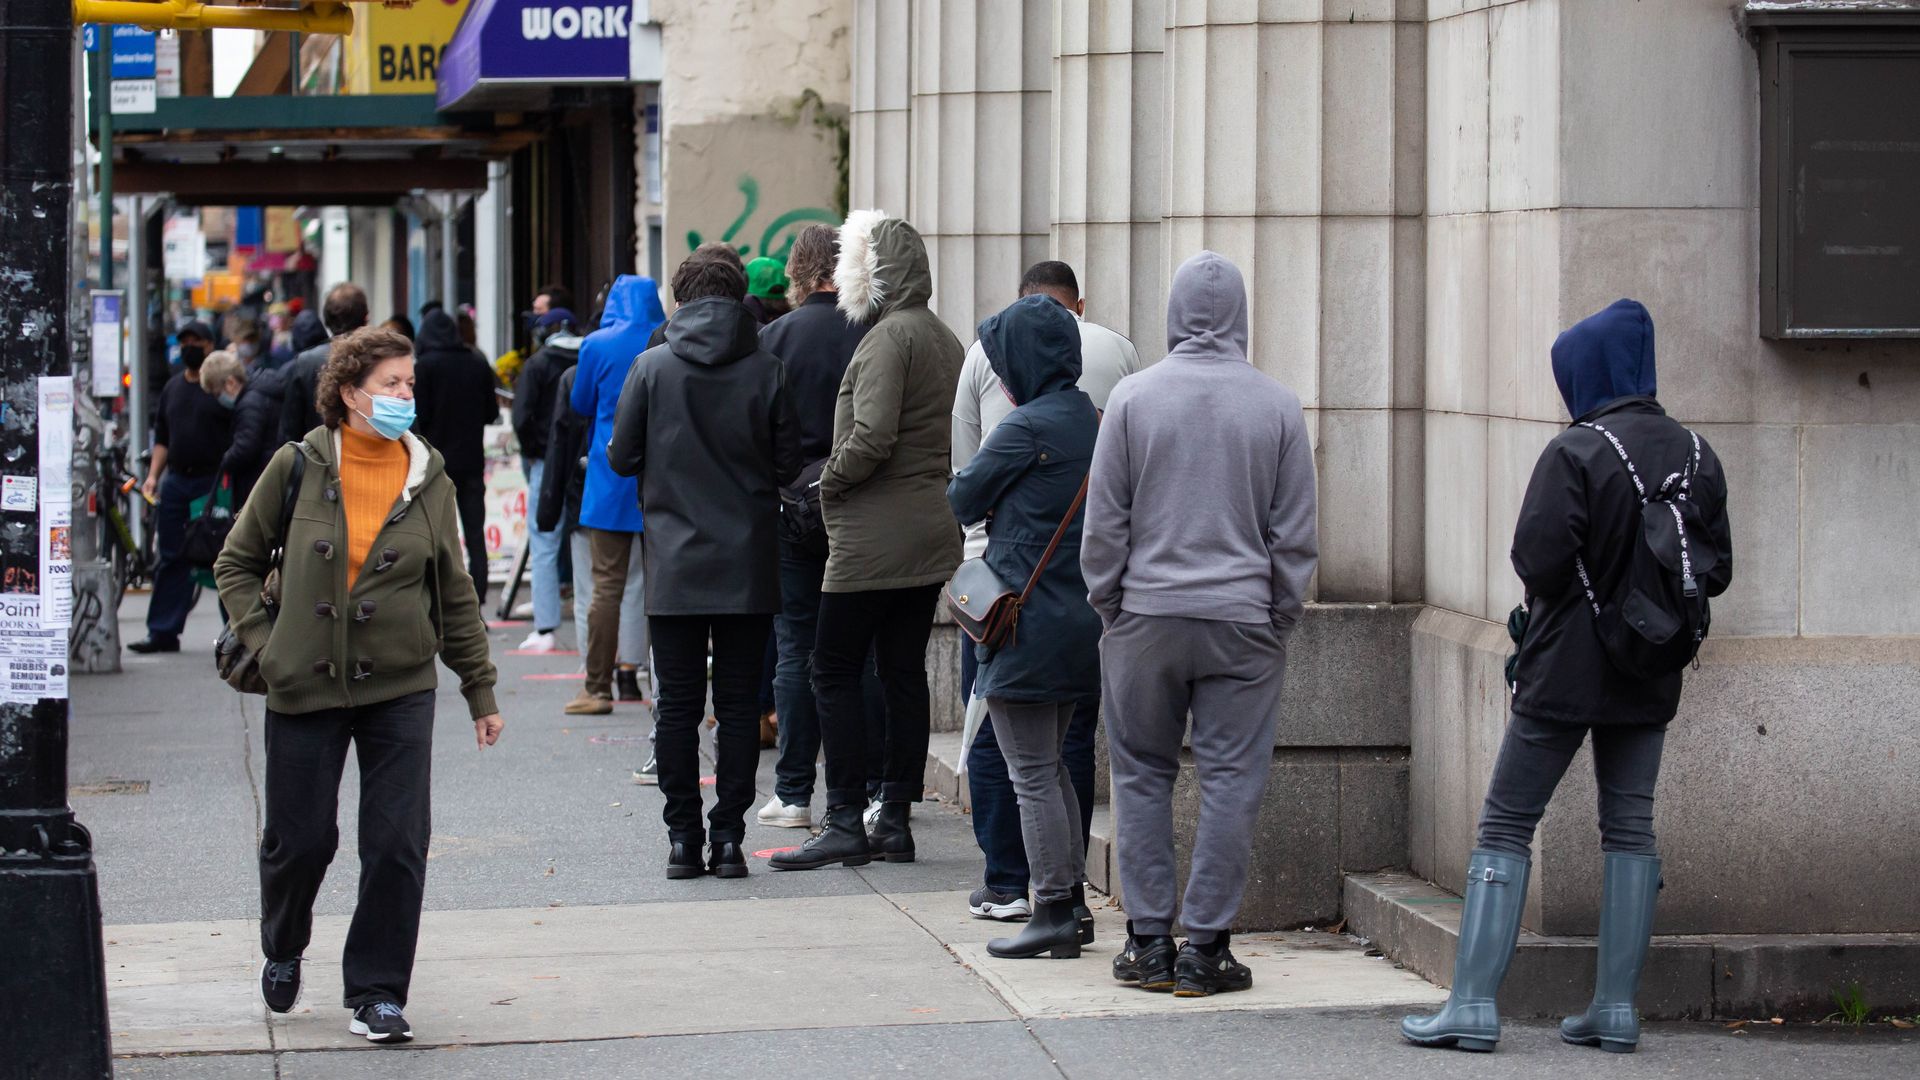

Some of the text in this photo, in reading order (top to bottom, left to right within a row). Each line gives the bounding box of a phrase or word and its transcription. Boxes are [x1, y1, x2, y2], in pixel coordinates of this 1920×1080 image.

[521, 5, 629, 40] WORK
[1604, 430, 1629, 460] adidas
[1669, 503, 1684, 535] adidas
[10, 671, 47, 681] REMOVAL
